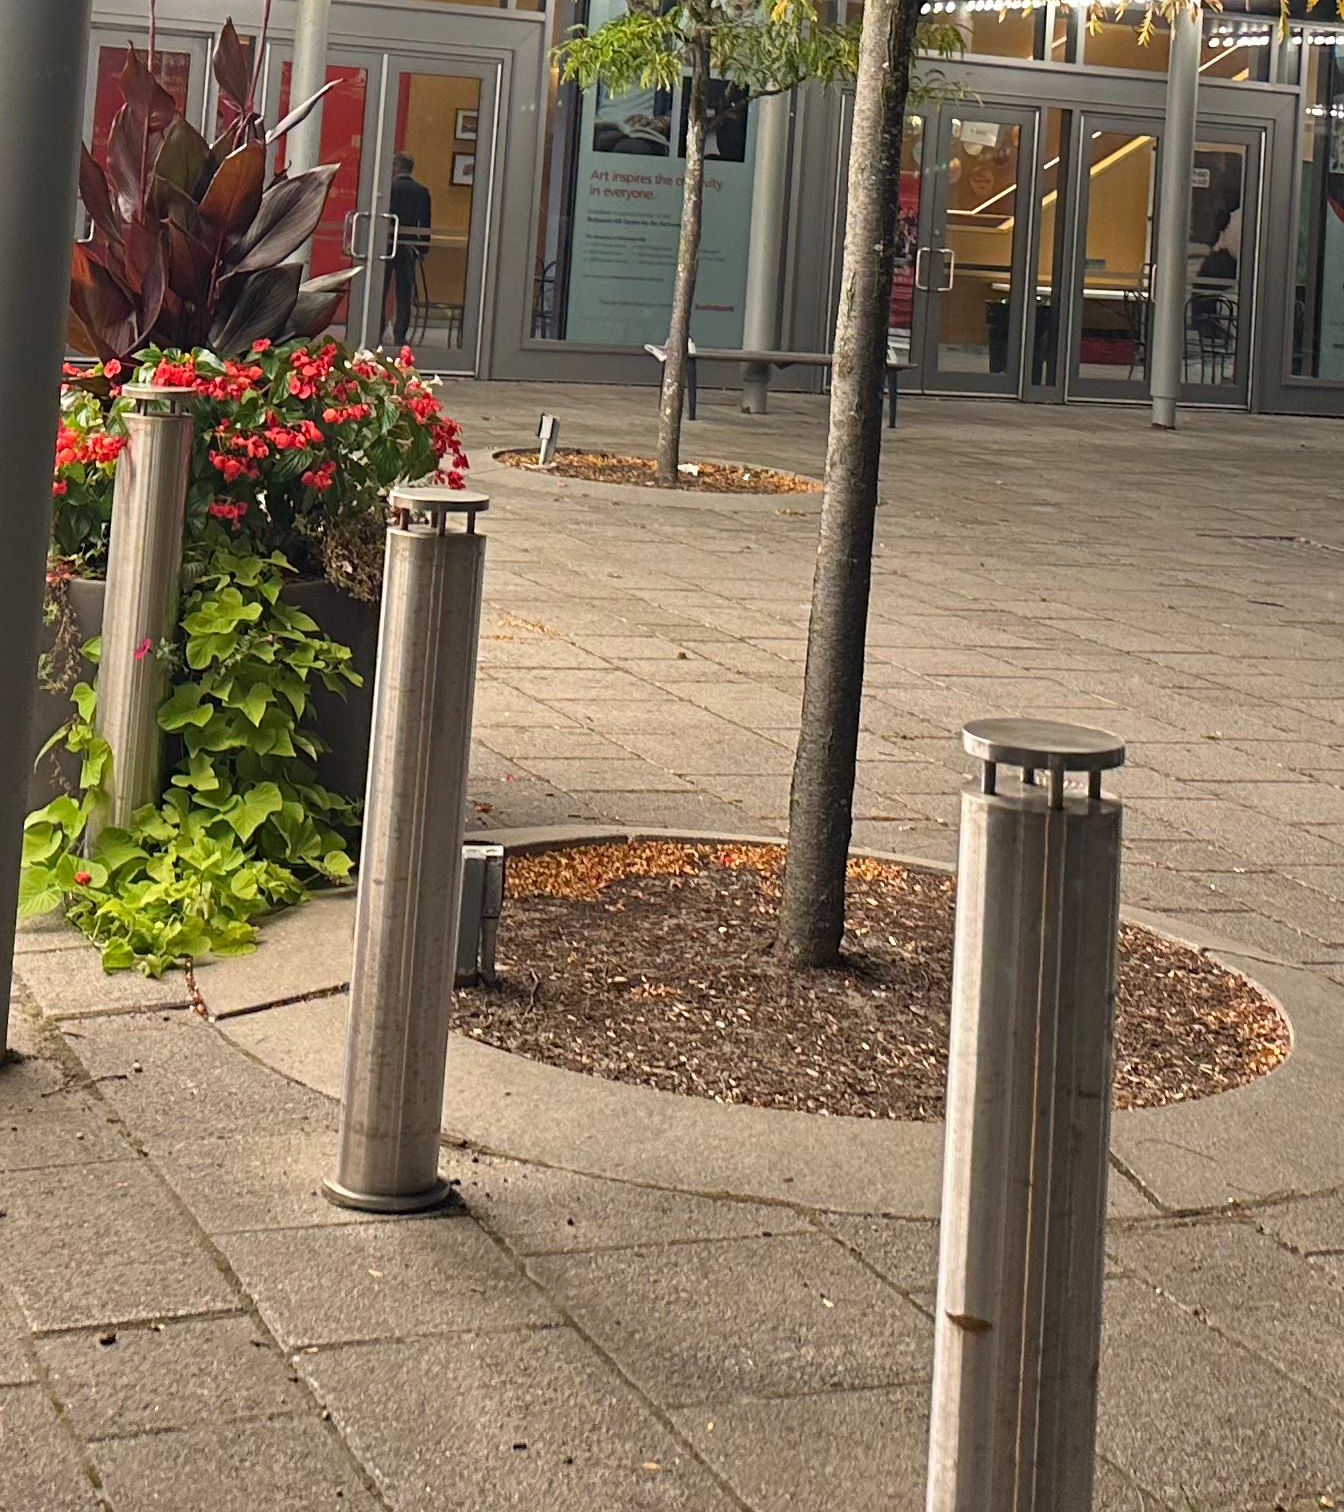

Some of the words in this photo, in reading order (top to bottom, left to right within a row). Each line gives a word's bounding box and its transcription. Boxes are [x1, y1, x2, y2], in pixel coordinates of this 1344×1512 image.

[591, 170, 609, 182] Art
[612, 171, 652, 185] inspires
[655, 173, 673, 186] the
[589, 184, 601, 197] in
